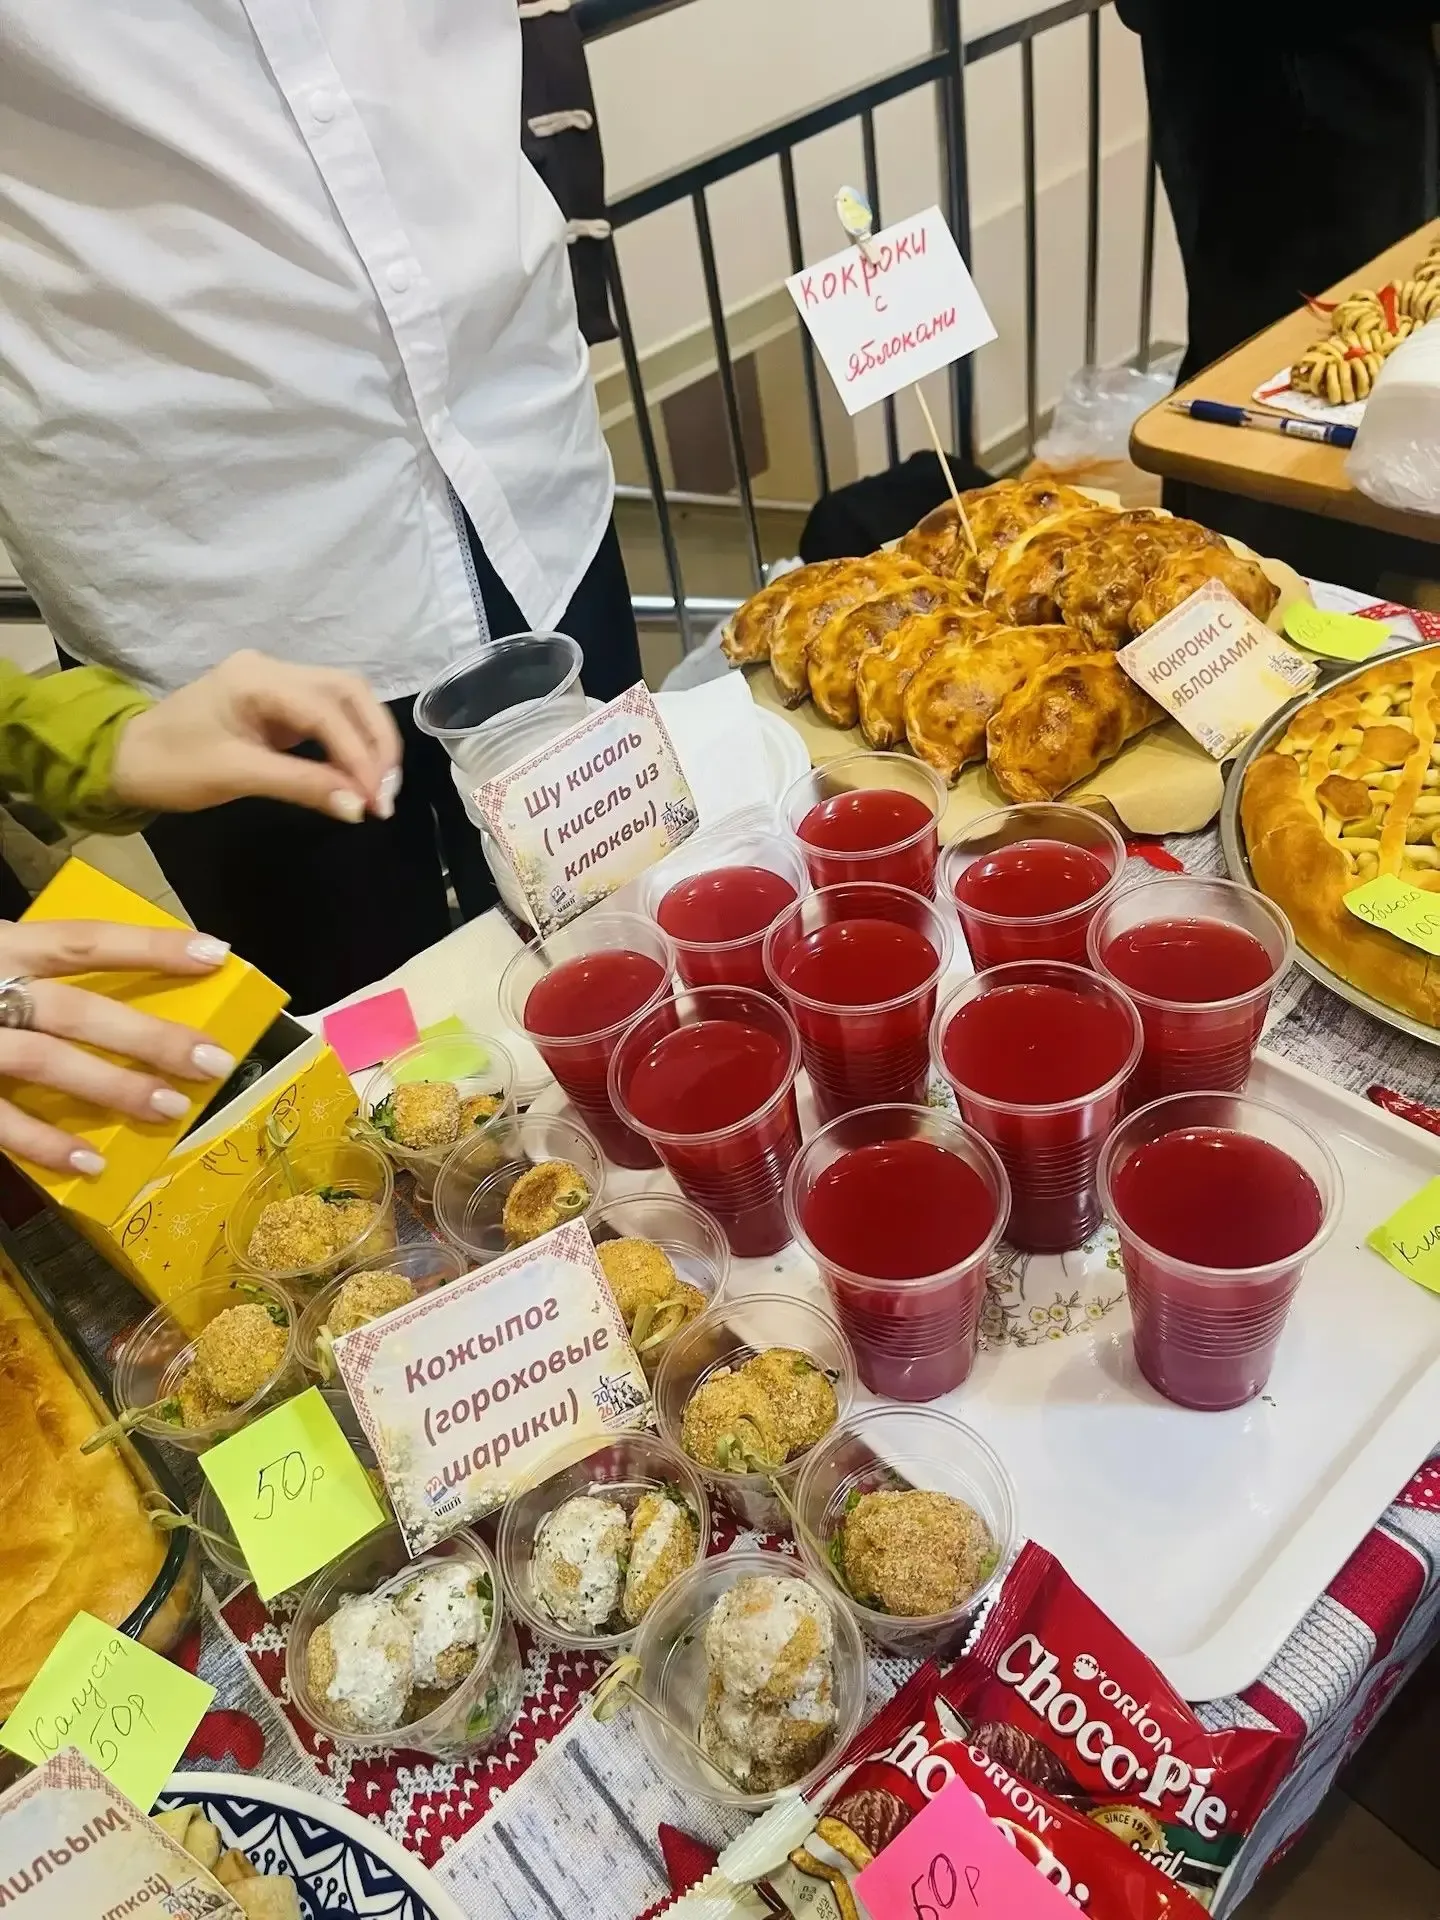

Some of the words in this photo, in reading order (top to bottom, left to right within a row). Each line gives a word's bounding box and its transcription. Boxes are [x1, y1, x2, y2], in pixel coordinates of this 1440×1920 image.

[1148, 627, 1219, 685] КОКРОКИ
[1221, 612, 1233, 631] С
[1170, 632, 1259, 708] ЯБЛОКАМИ
[523, 782, 561, 819] Шу
[566, 731, 642, 792] кисаль
[635, 762, 660, 789] из
[564, 799, 658, 882] клюквы)
[404, 1297, 560, 1394] Кожыпог
[423, 1327, 610, 1447] (гороховые
[441, 1387, 580, 1488] шарики)
[967, 1745, 1054, 1834] ORION
[1103, 1812, 1131, 1825] SINCE
[1131, 1818, 1153, 1841] 1974
